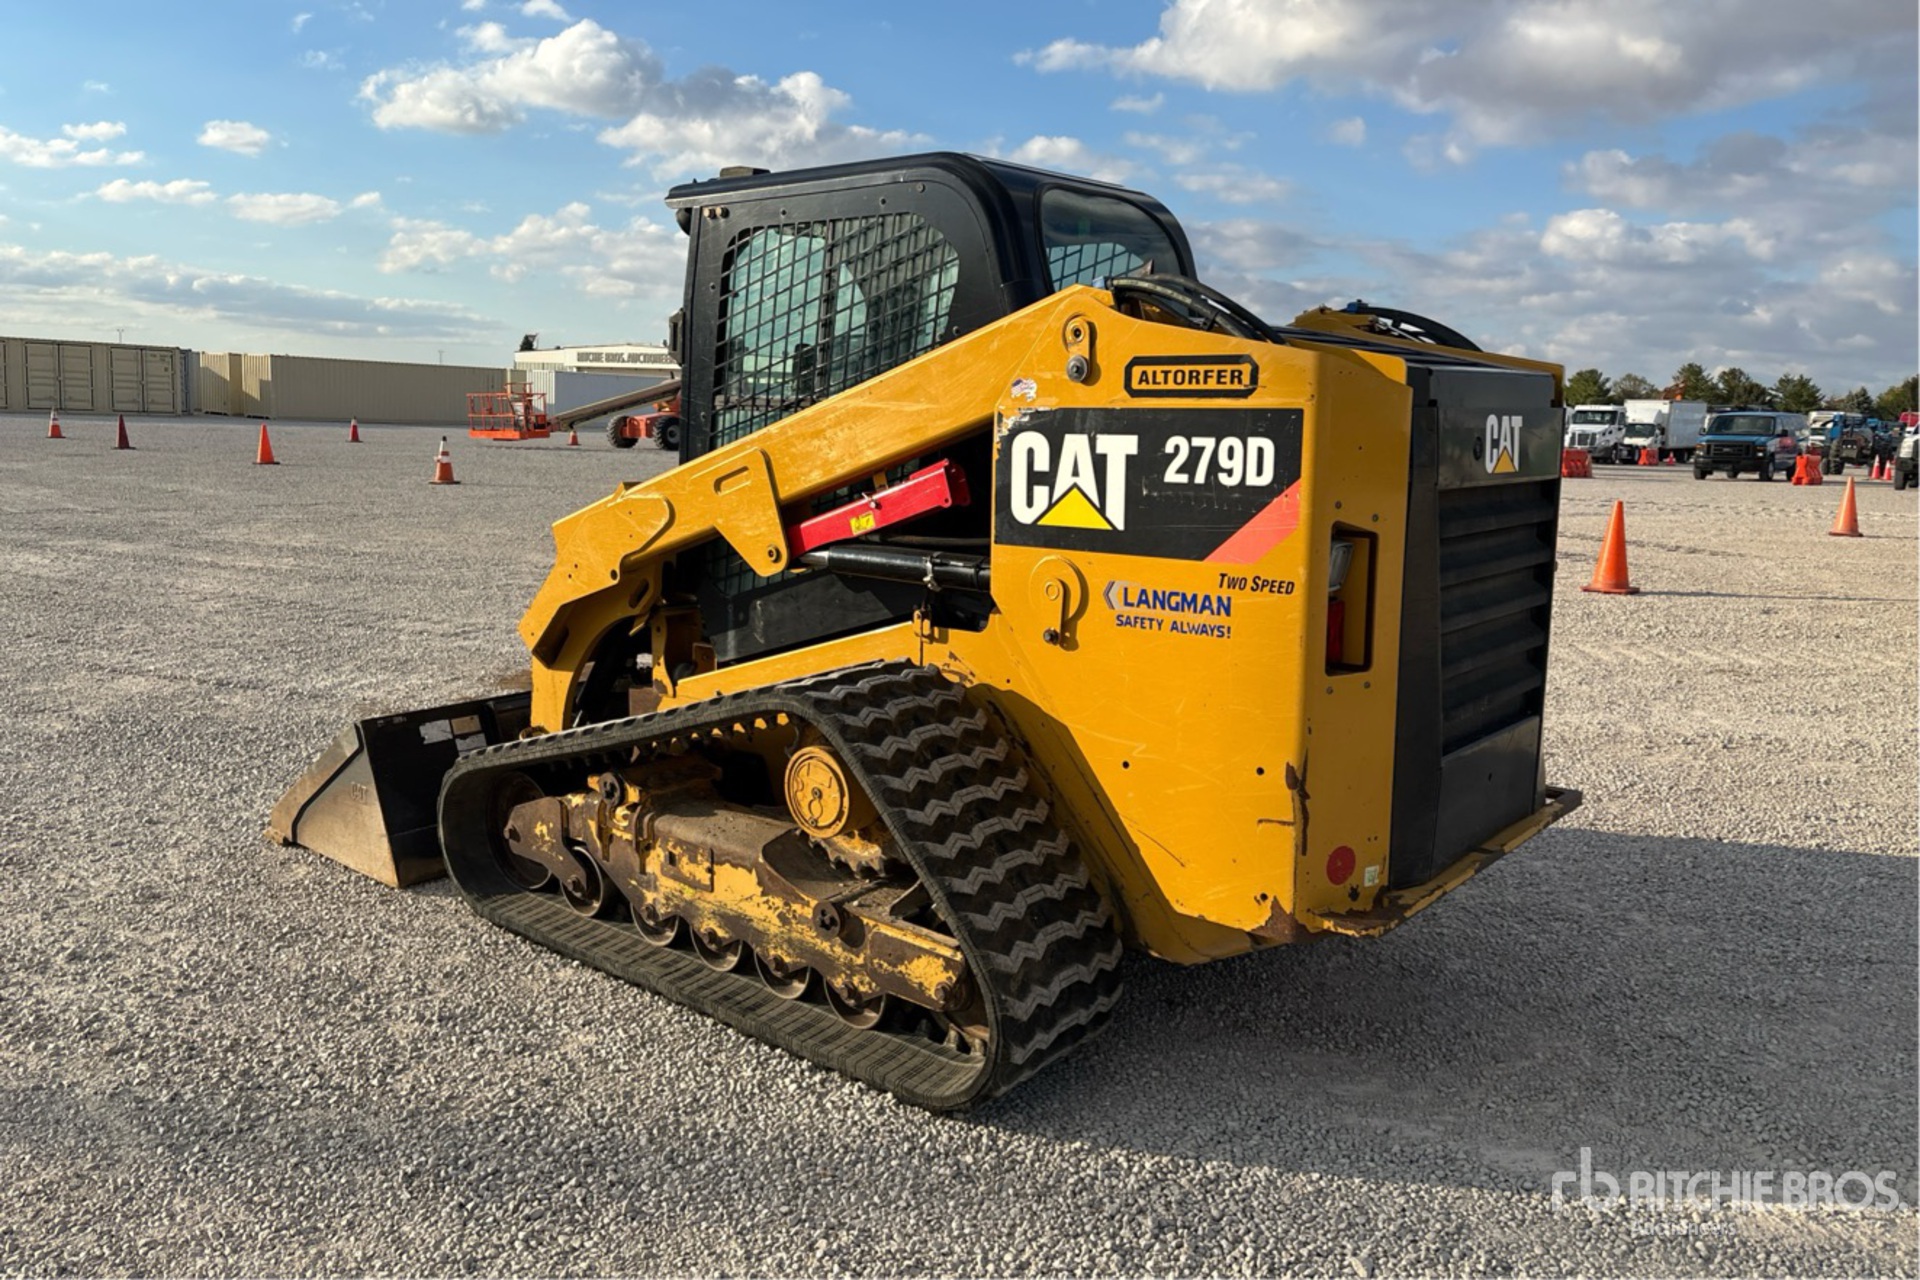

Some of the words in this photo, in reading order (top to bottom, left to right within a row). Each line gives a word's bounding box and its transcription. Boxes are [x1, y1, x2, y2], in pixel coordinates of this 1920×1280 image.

[1137, 368, 1244, 386] ALTORFER
[1484, 413, 1523, 475] CAT
[1010, 430, 1139, 531] CAT
[1163, 435, 1275, 487] 279D
[1123, 587, 1232, 617] LANGMAN
[1116, 614, 1164, 631] SAFETY
[1170, 620, 1231, 639] ALWAYS!
